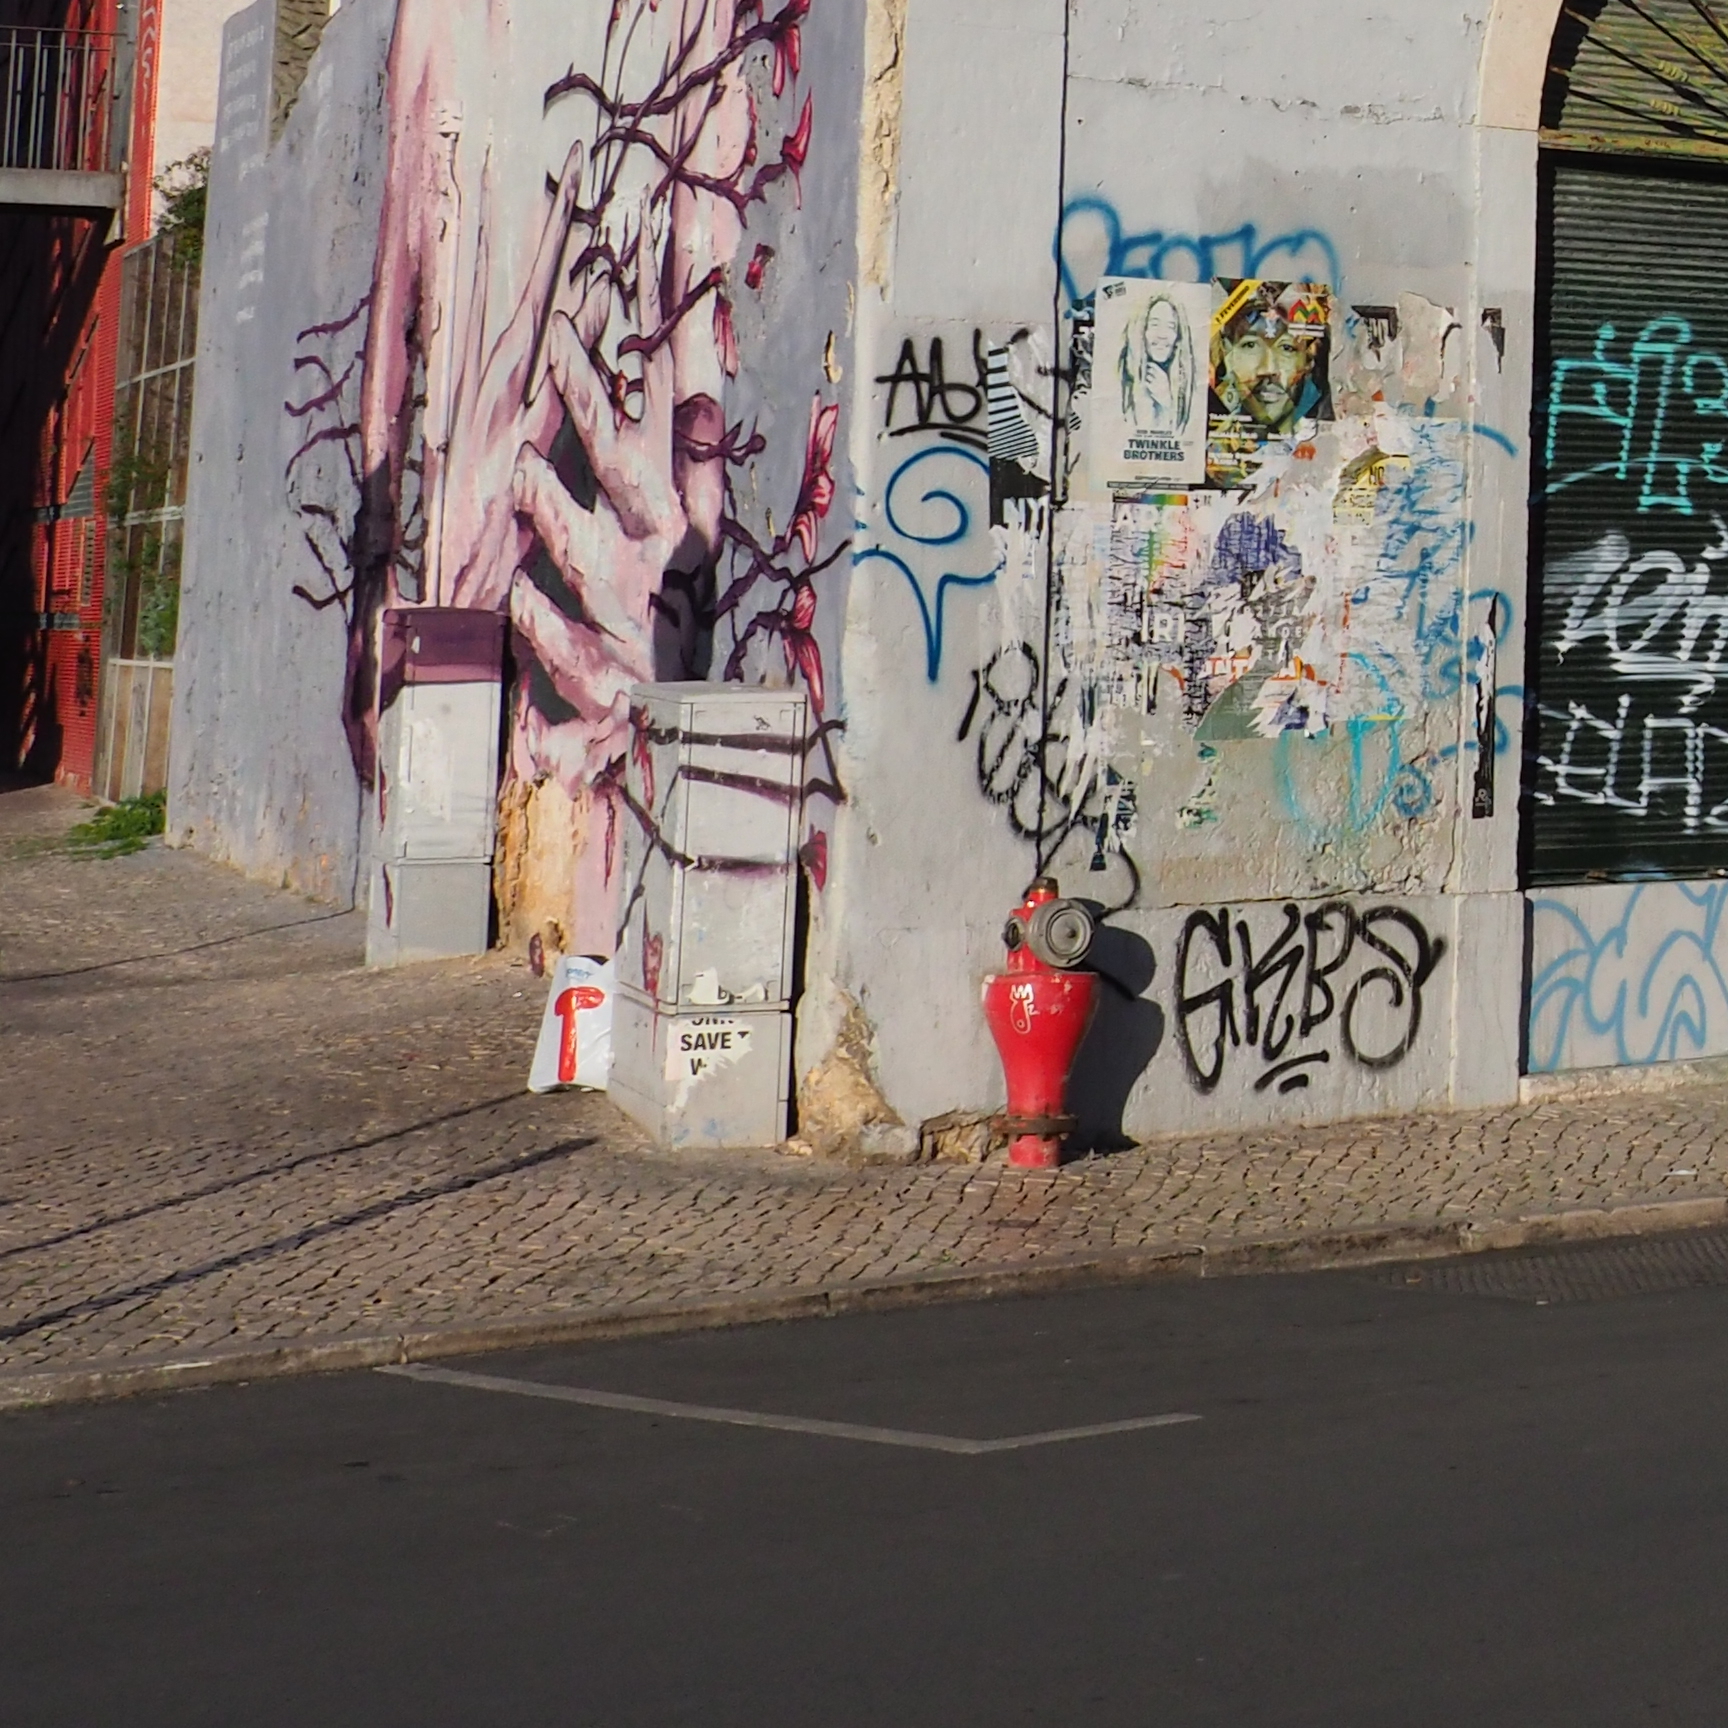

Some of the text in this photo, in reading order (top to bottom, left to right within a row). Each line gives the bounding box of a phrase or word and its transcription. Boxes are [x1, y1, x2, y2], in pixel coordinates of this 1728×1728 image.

[1127, 438, 1181, 452] TWINKLE
[1122, 449, 1186, 463] BROTHERS
[680, 1031, 732, 1052] SAVE
